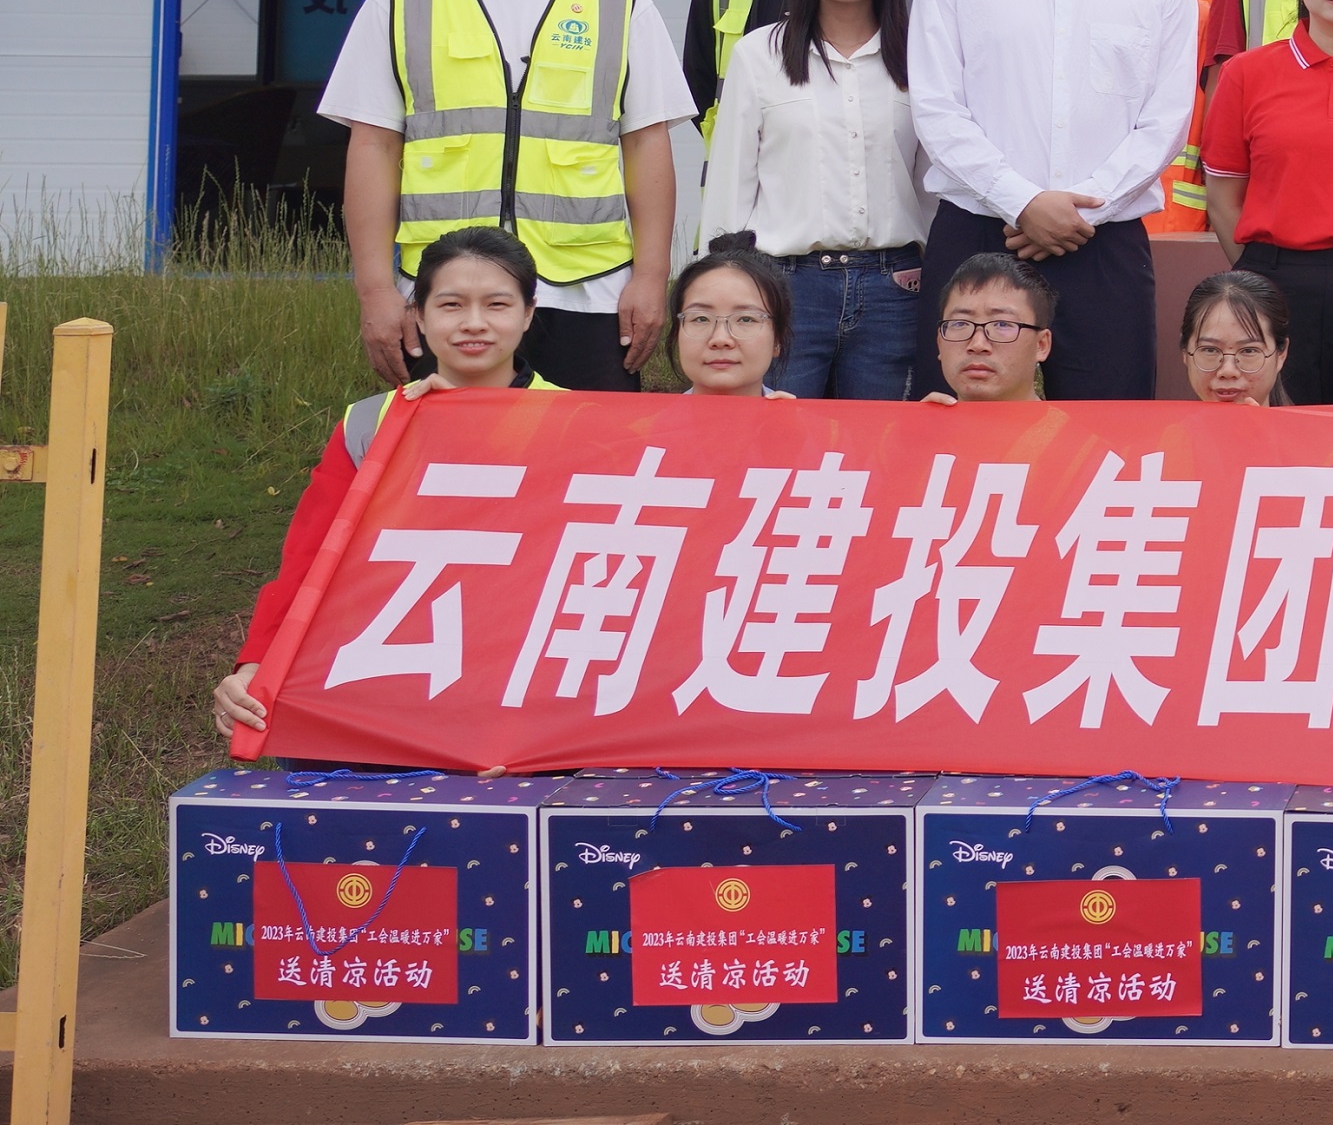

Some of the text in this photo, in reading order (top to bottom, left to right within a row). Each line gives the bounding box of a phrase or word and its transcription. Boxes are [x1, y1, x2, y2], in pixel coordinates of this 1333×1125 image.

[551, 33, 592, 47] 云南建投
[278, 956, 433, 989] 送清凉活动
[659, 958, 810, 991] 送清凉活动
[1023, 972, 1176, 1005] 送清凉活动
